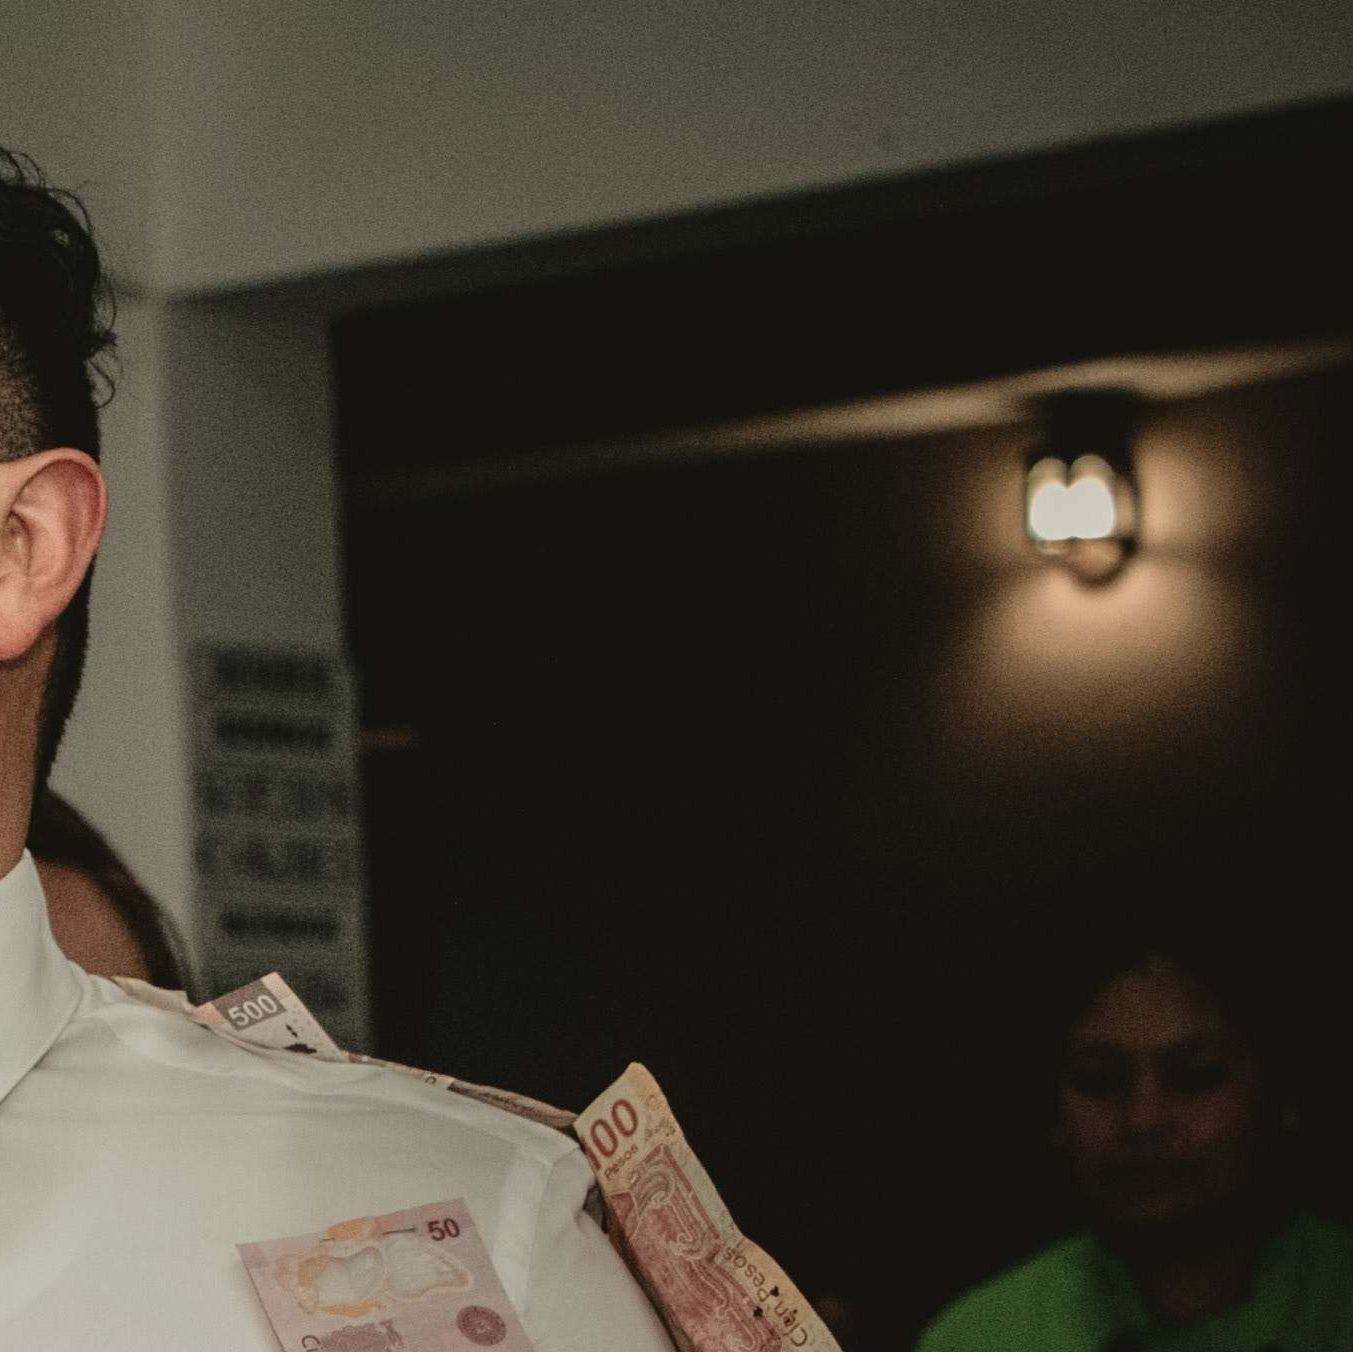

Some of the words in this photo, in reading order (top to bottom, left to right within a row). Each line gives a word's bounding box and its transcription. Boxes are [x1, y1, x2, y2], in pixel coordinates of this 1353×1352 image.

[227, 993, 278, 1027] 500
[604, 1143, 639, 1180] Pesos
[427, 1217, 460, 1243] 50
[723, 1247, 772, 1302] Pesos
[773, 1302, 808, 1347] Cien
